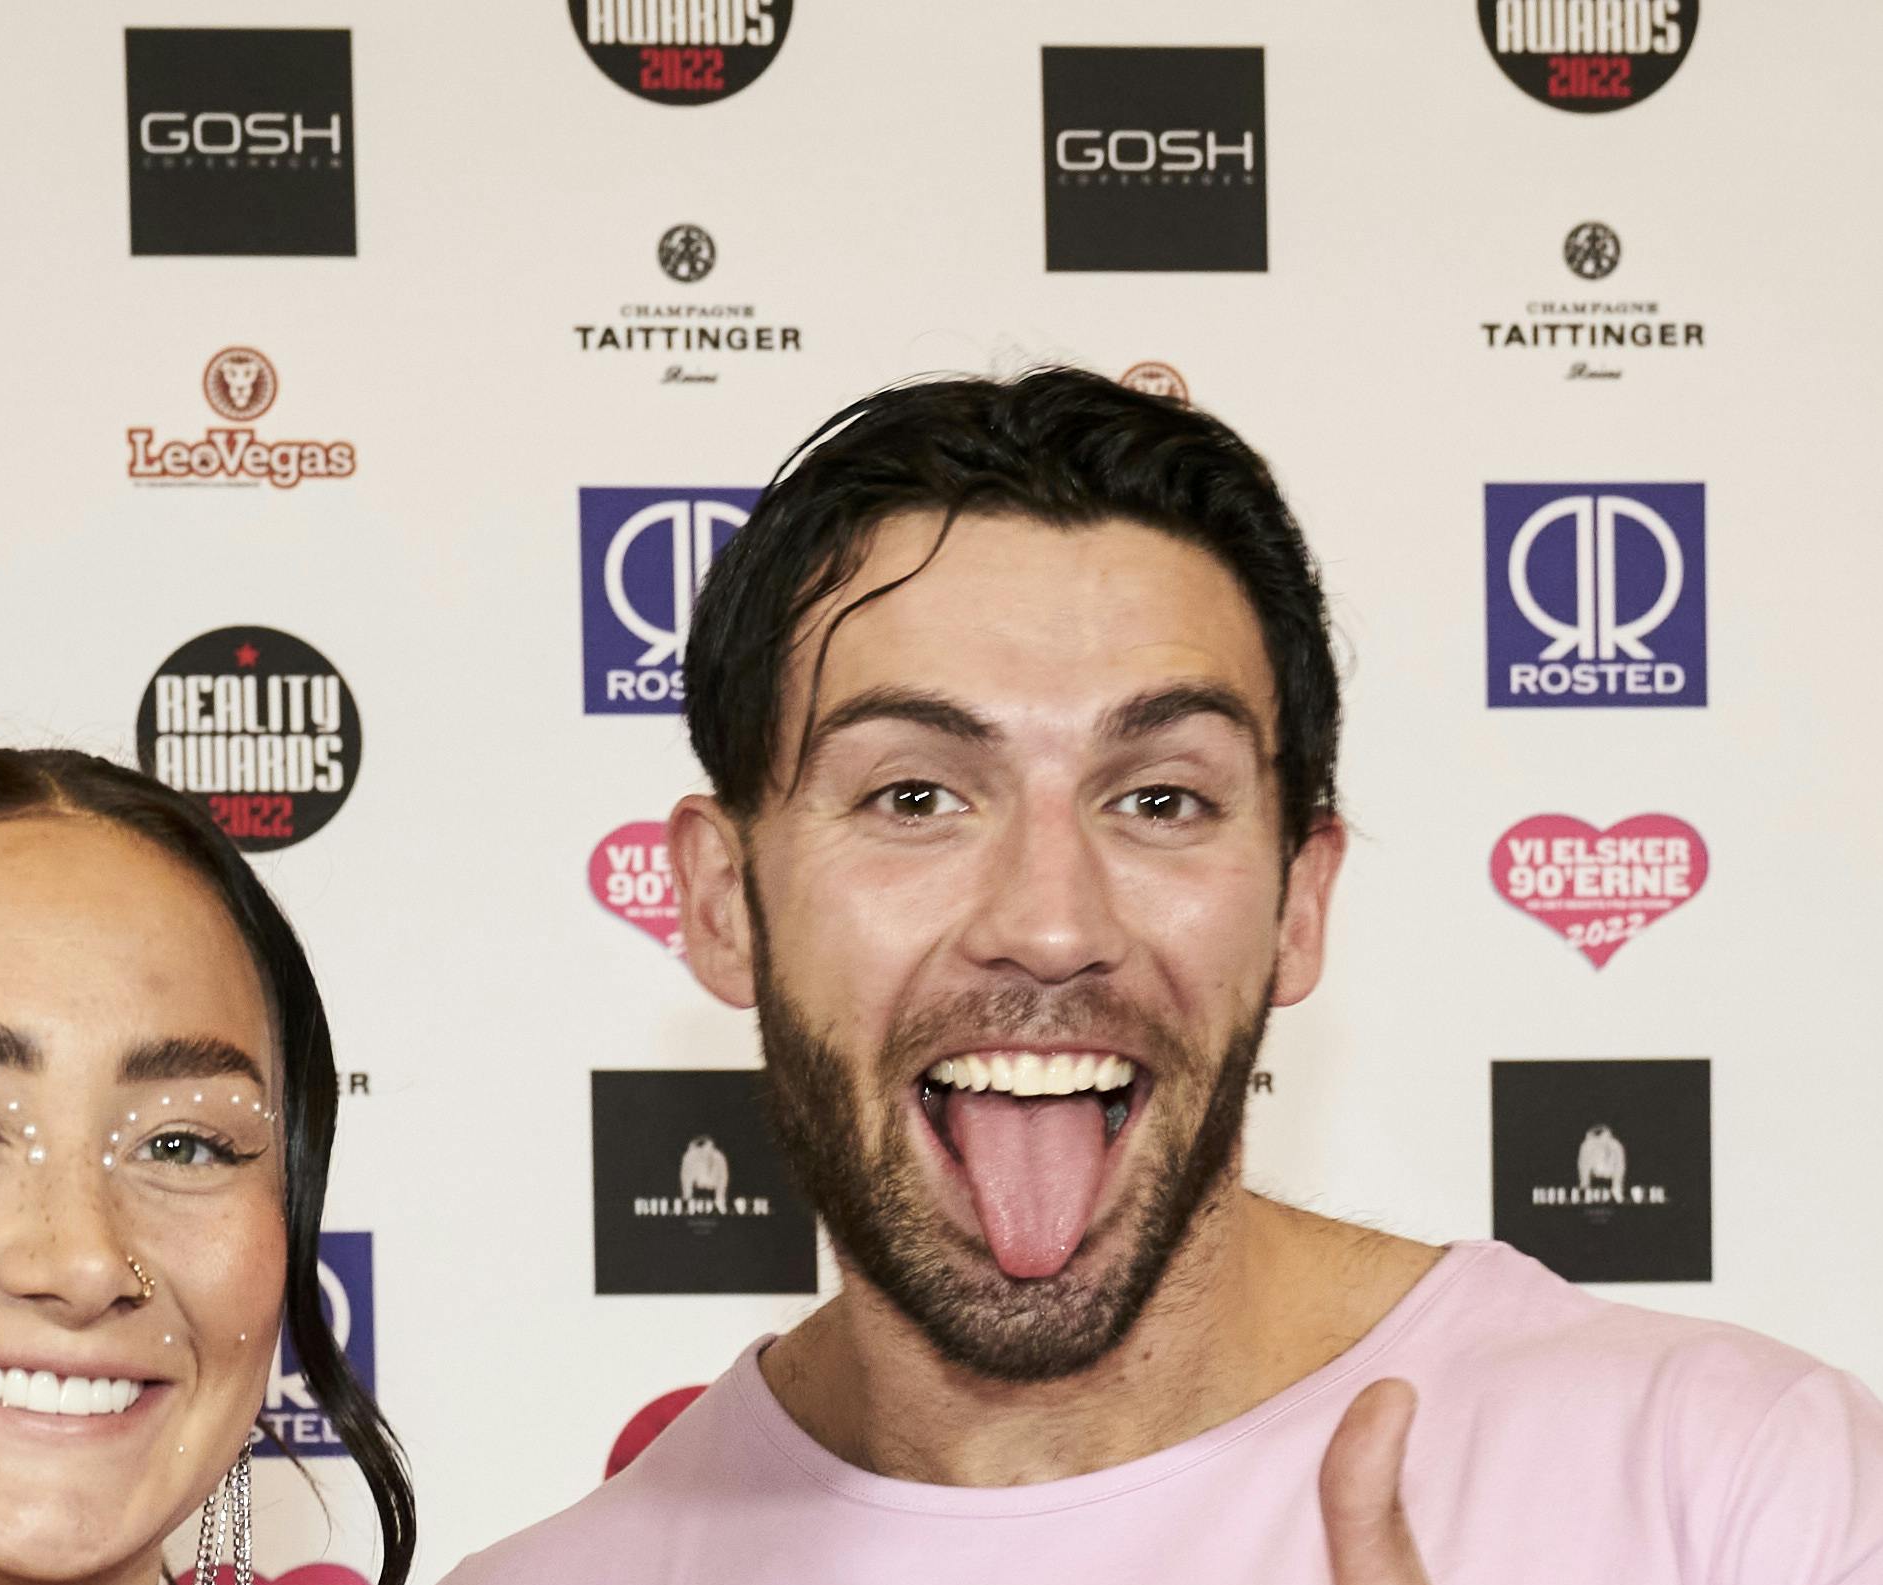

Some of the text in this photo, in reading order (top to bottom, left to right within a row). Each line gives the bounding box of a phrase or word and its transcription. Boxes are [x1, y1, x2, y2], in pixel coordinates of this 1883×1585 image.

[586, 0, 775, 46] AWARDS
[1496, 0, 1681, 54] AWARDS
[640, 48, 725, 90] 2022
[1548, 57, 1631, 97] 2022
[140, 112, 341, 154] GOSH
[1056, 130, 1254, 171] GOSH
[620, 305, 755, 318] CHAMPAGNE
[1526, 302, 1659, 315] CHAMPAGNE
[575, 326, 800, 350] TAITTINGER
[1482, 323, 1704, 347] TAITTINGER
[125, 428, 358, 490] LeoVegas
[606, 669, 686, 701] ROS
[1510, 663, 1685, 695] ROSTED
[155, 675, 340, 733] REALITY
[155, 734, 344, 793] AWARDS
[209, 795, 293, 837] 2022
[607, 845, 645, 874] VI
[1508, 837, 1690, 866] VI ELSKER
[1508, 866, 1691, 897] 90'ERNE
[1566, 912, 1647, 948] 2022
